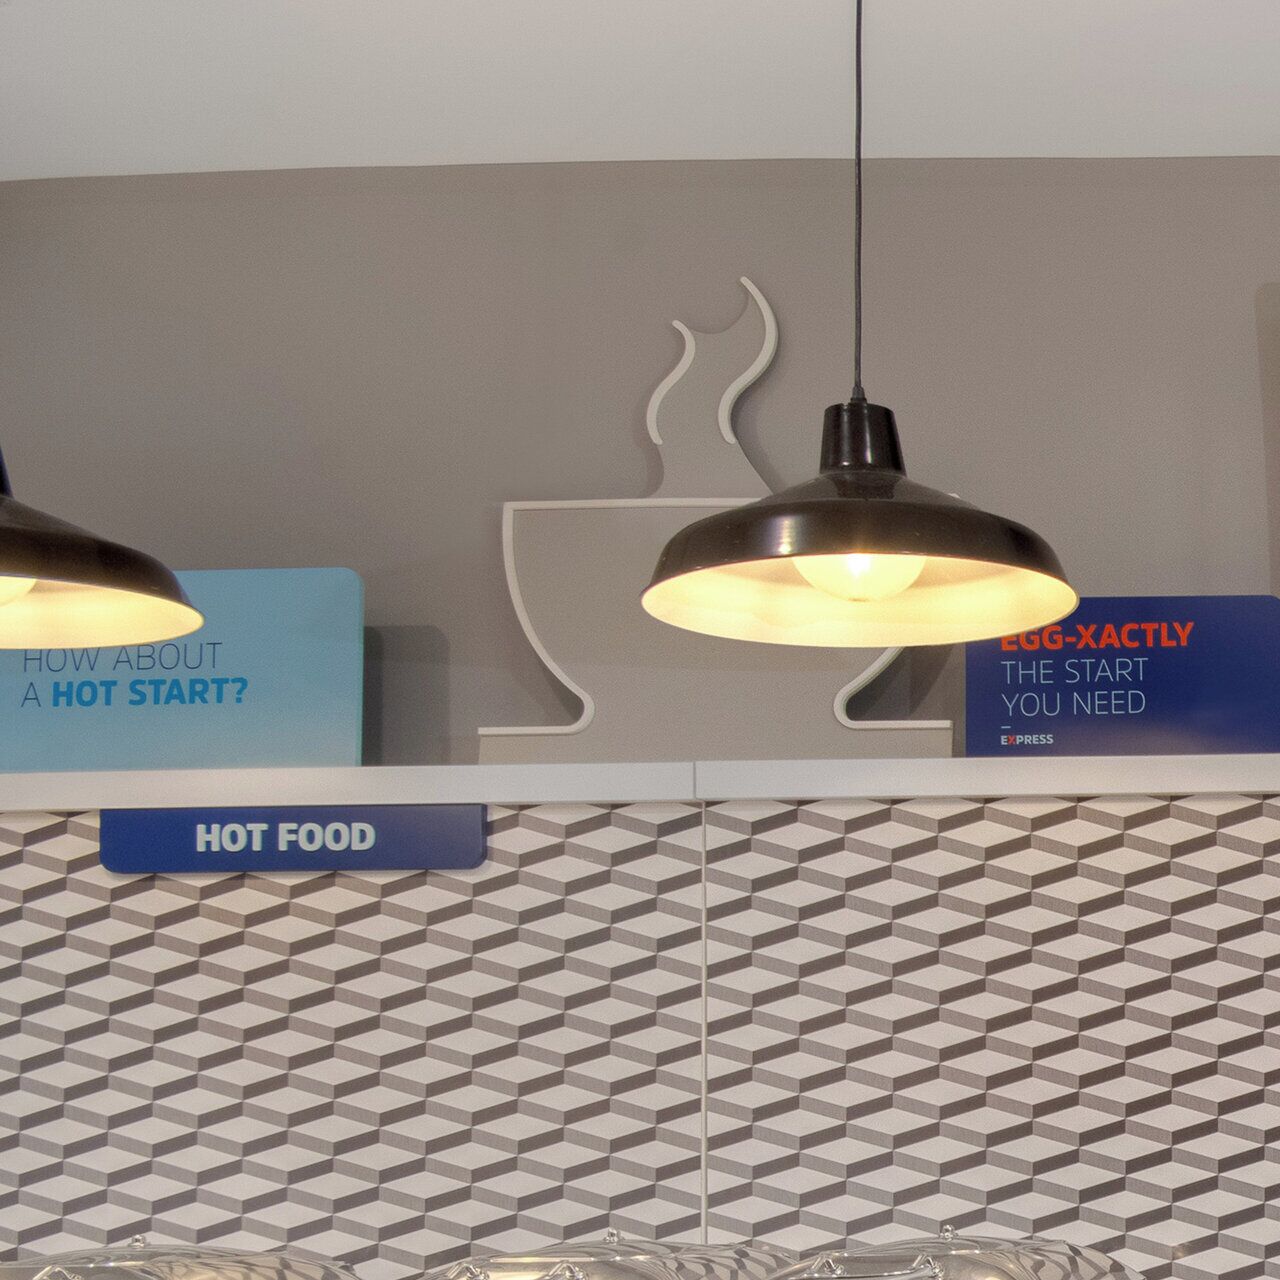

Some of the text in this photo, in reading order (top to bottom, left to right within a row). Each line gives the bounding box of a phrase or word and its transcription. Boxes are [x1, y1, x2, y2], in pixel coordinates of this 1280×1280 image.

[1001, 622, 1195, 651] EGG-XACTLY
[23, 642, 223, 672] HOW ABOUT
[1000, 658, 1149, 684] THE START
[20, 677, 248, 707] A HOT START?
[1001, 690, 1146, 717] YOU NEED
[1000, 734, 1054, 746] EXPRESS
[196, 822, 376, 852] HOT FOOD
